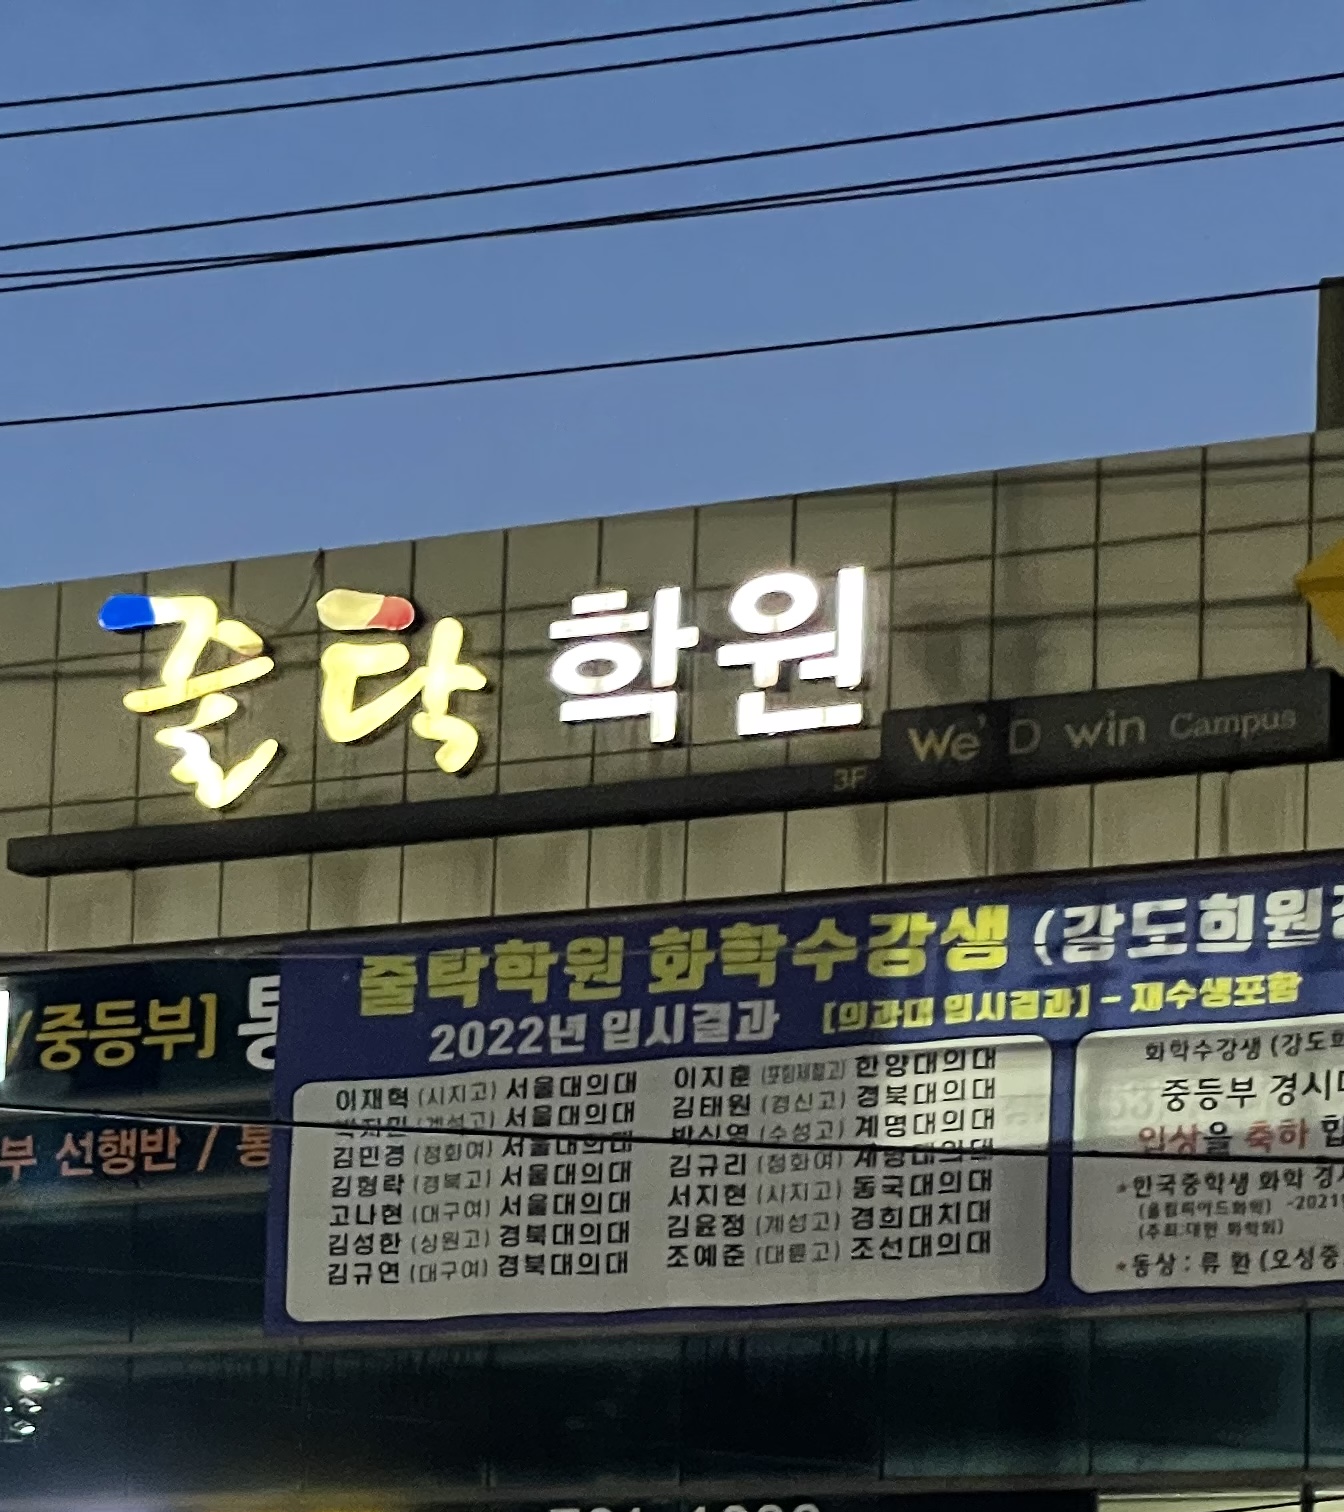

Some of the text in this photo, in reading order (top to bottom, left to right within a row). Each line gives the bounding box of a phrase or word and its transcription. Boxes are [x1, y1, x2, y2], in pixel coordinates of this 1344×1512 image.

[549, 567, 866, 745] 학원
[1010, 719, 1041, 754] D
[1064, 711, 1147, 748] win
[1168, 707, 1297, 743] Campus
[833, 766, 868, 792] 3F
[649, 903, 1009, 994] 화학수강생
[1131, 971, 1303, 1013] 재수생포함
[428, 1000, 780, 1063] 2022년 입시결과
[674, 1064, 751, 1089] 이지훈
[855, 1047, 996, 1079] 한양대의대
[1145, 1039, 1261, 1062] 화학수강생
[506, 1071, 637, 1099] 서울대의대
[672, 1094, 751, 1120] 김태원
[857, 1077, 995, 1108] 경북대의대
[1161, 1077, 1258, 1112] 중등부
[505, 1101, 635, 1127] 서울대의대
[855, 1107, 994, 1139] 계명대의대
[55, 1126, 180, 1177] 선행반
[1245, 1118, 1310, 1153] 축하
[333, 1144, 405, 1169] 김민경
[500, 1160, 632, 1187] 서울대의대
[669, 1153, 746, 1178] 김규리
[668, 1183, 746, 1207] 서지현
[853, 1168, 993, 1199] 동국대의대
[330, 1190, 631, 1226] 고나현 (대구여) 서울대의대
[851, 1199, 991, 1229] 경희대치대
[329, 1232, 401, 1257] 김성한
[499, 1220, 630, 1248] 경북대의대
[666, 1243, 745, 1269] 조예준
[850, 1230, 991, 1261] 조선대의대
[328, 1251, 629, 1286] 김규연 (대구여) 경북대의대
